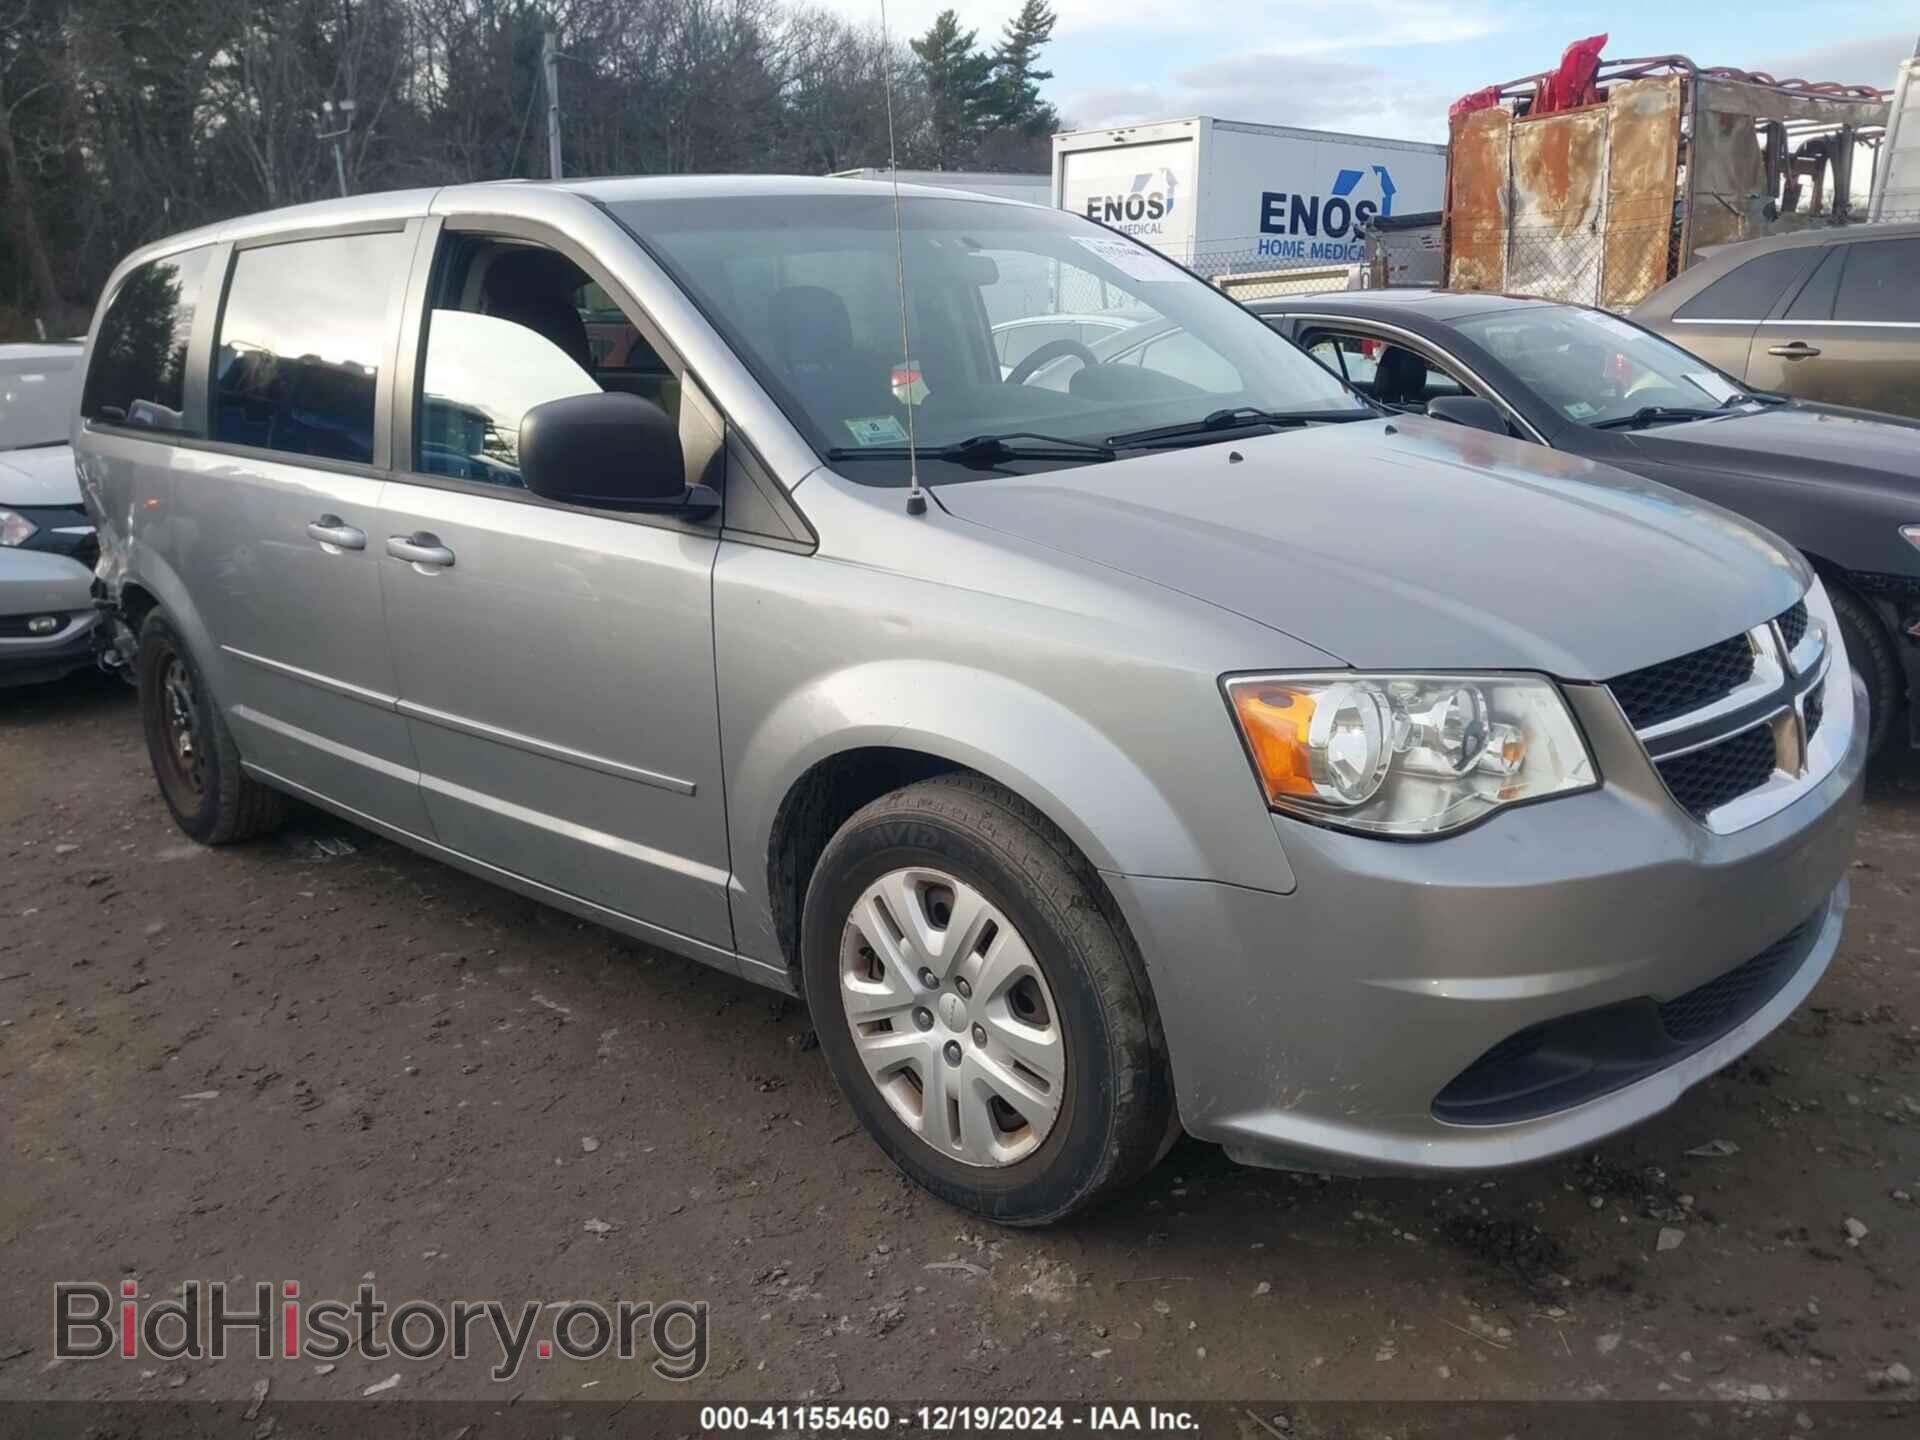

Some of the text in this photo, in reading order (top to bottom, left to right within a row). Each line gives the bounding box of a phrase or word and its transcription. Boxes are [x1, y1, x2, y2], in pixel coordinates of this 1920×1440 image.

[1087, 192, 1164, 222] ENOS
[1260, 191, 1377, 240] ENOS
[1258, 239, 1366, 261] HOME MEDICA
